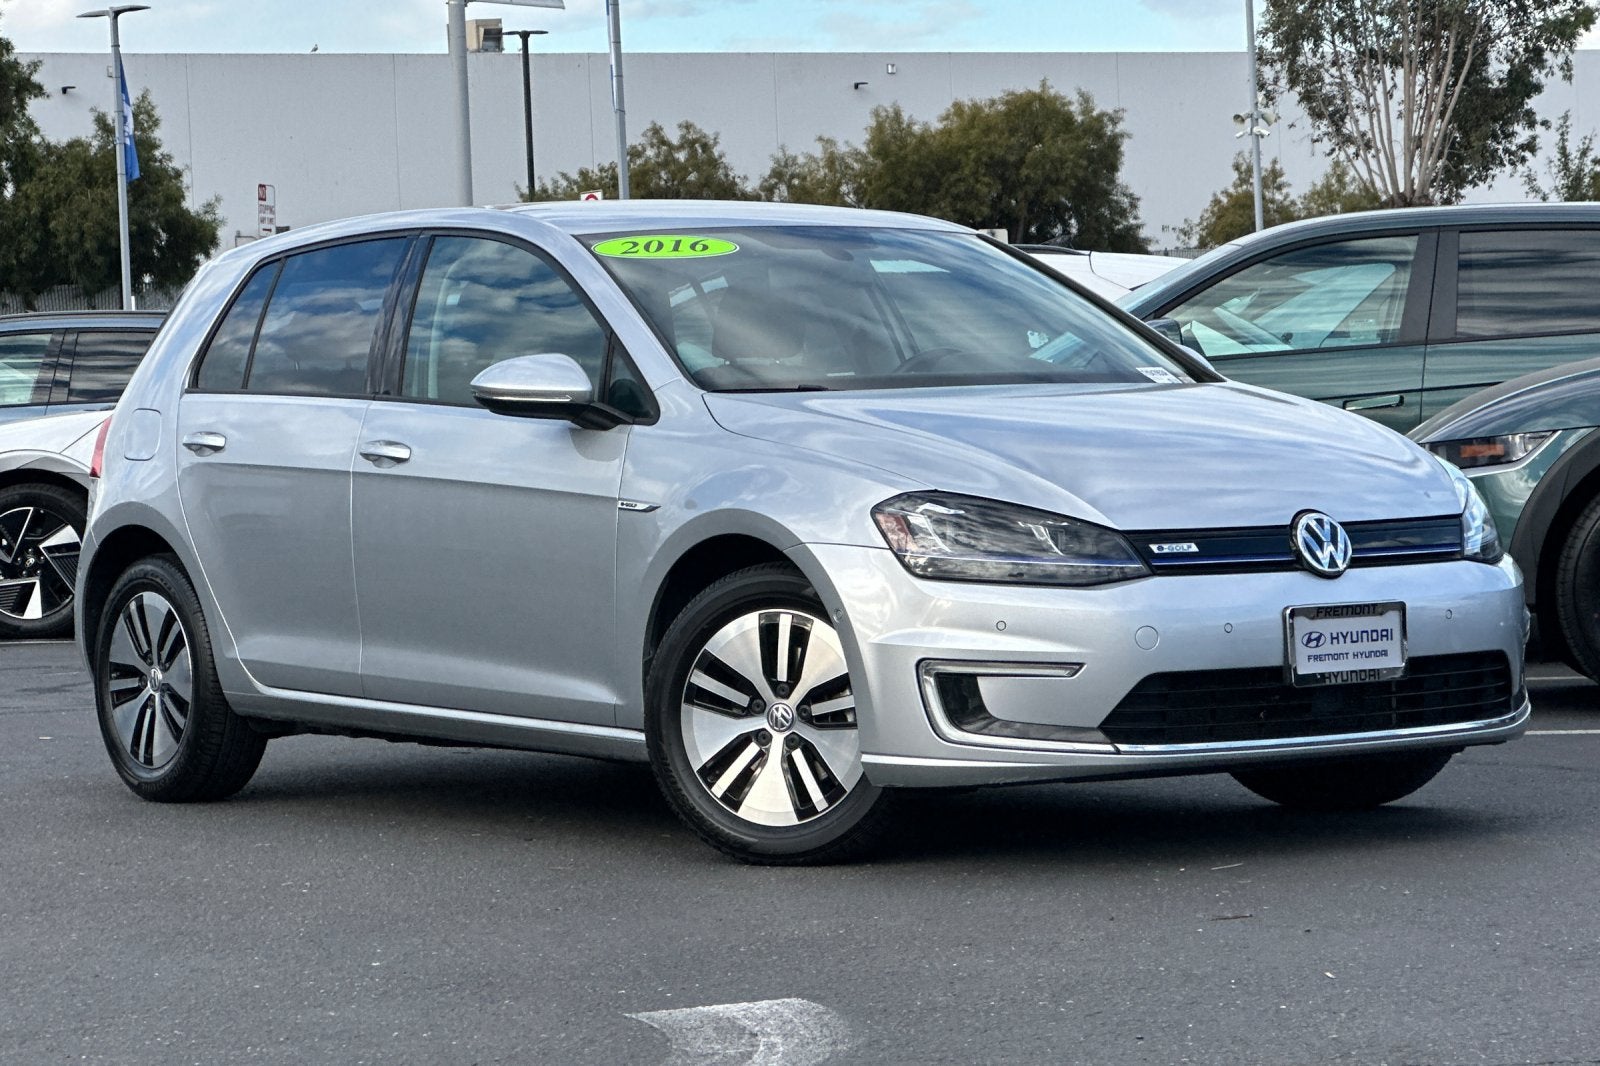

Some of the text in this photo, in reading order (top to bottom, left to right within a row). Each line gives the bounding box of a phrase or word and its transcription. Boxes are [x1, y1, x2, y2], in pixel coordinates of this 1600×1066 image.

[620, 239, 709, 254] 2016
[1316, 604, 1378, 617] FREMONT
[1330, 628, 1393, 645] HYUNDAI
[1307, 649, 1389, 663] FREMONT HYUNDAI
[1324, 669, 1381, 683] HYUNDAI
